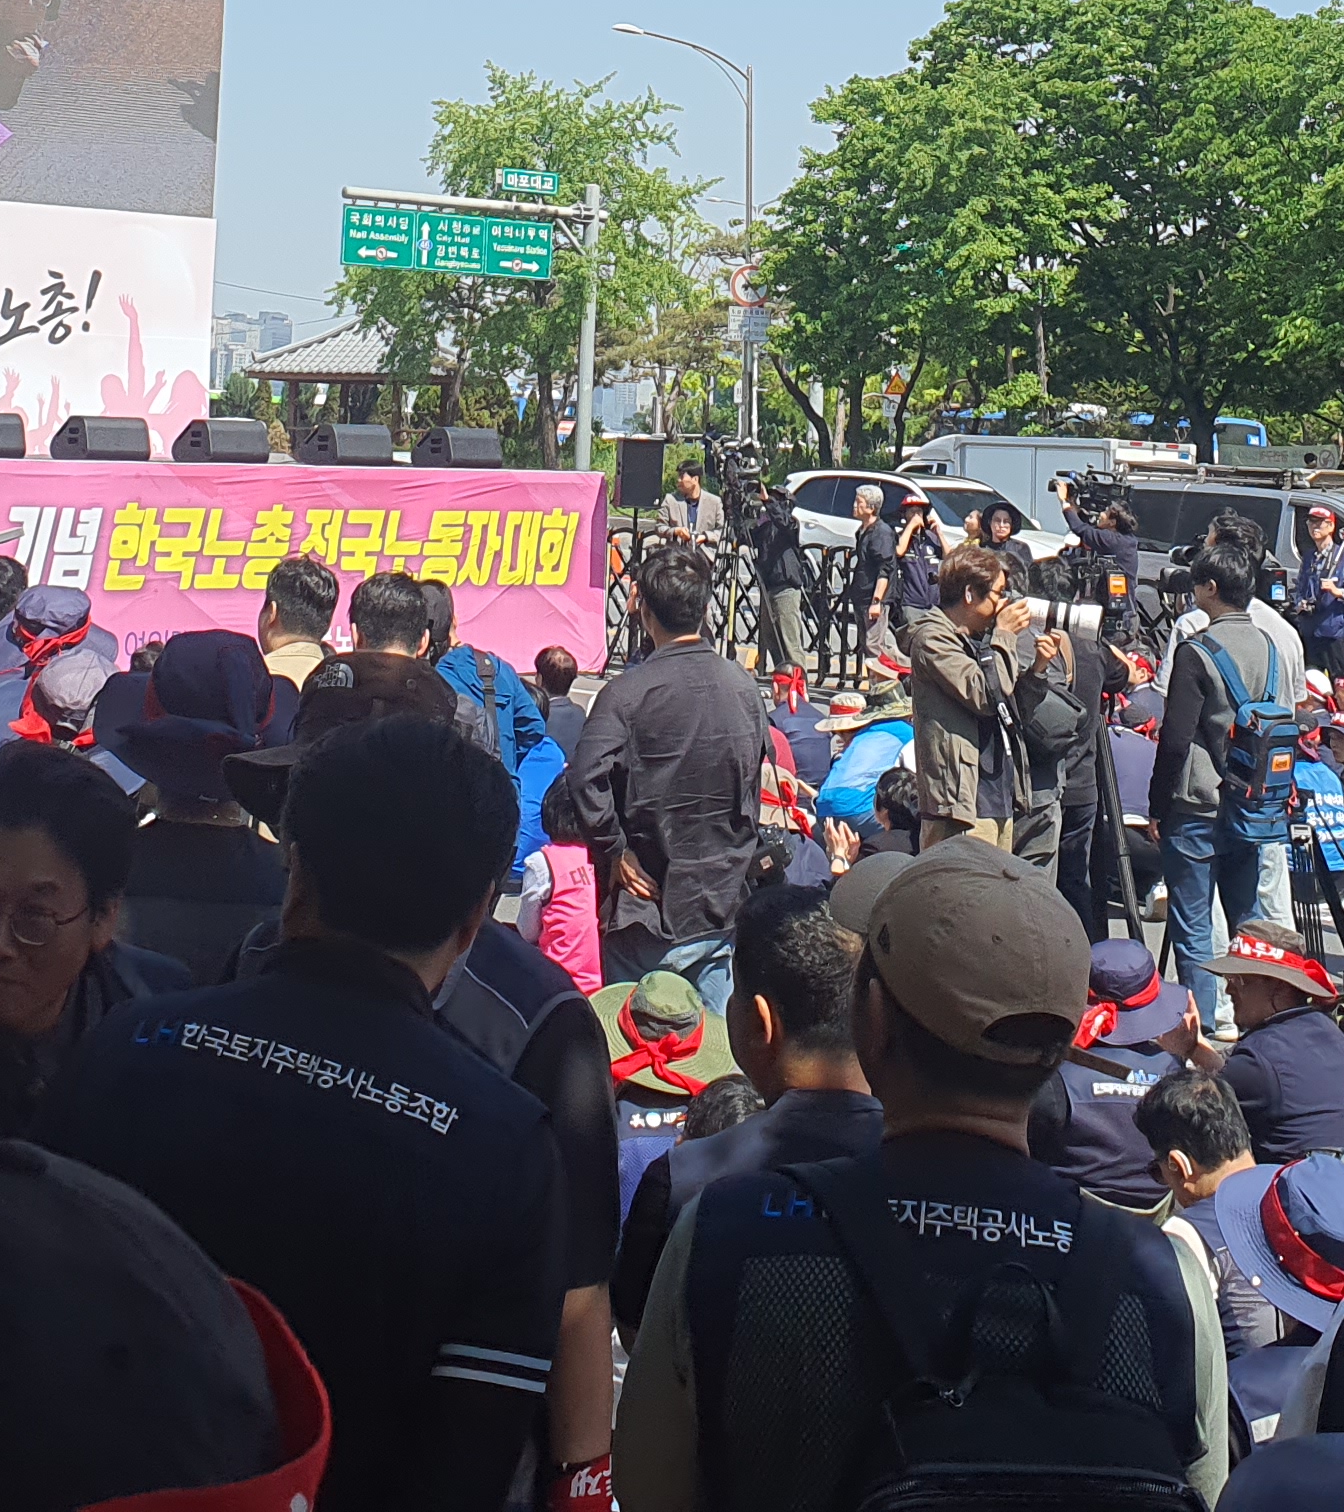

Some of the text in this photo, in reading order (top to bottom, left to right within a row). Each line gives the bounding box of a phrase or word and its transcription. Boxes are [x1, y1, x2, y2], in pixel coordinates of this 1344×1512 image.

[506, 173, 554, 191] 마포대교
[369, 230, 409, 245] Assembly
[8, 506, 104, 592] 기념
[103, 501, 295, 592] 한국노총
[180, 1021, 460, 1135] 한국토지주택공사노동조합
[887, 1199, 1074, 1254] 지주택공사노동
